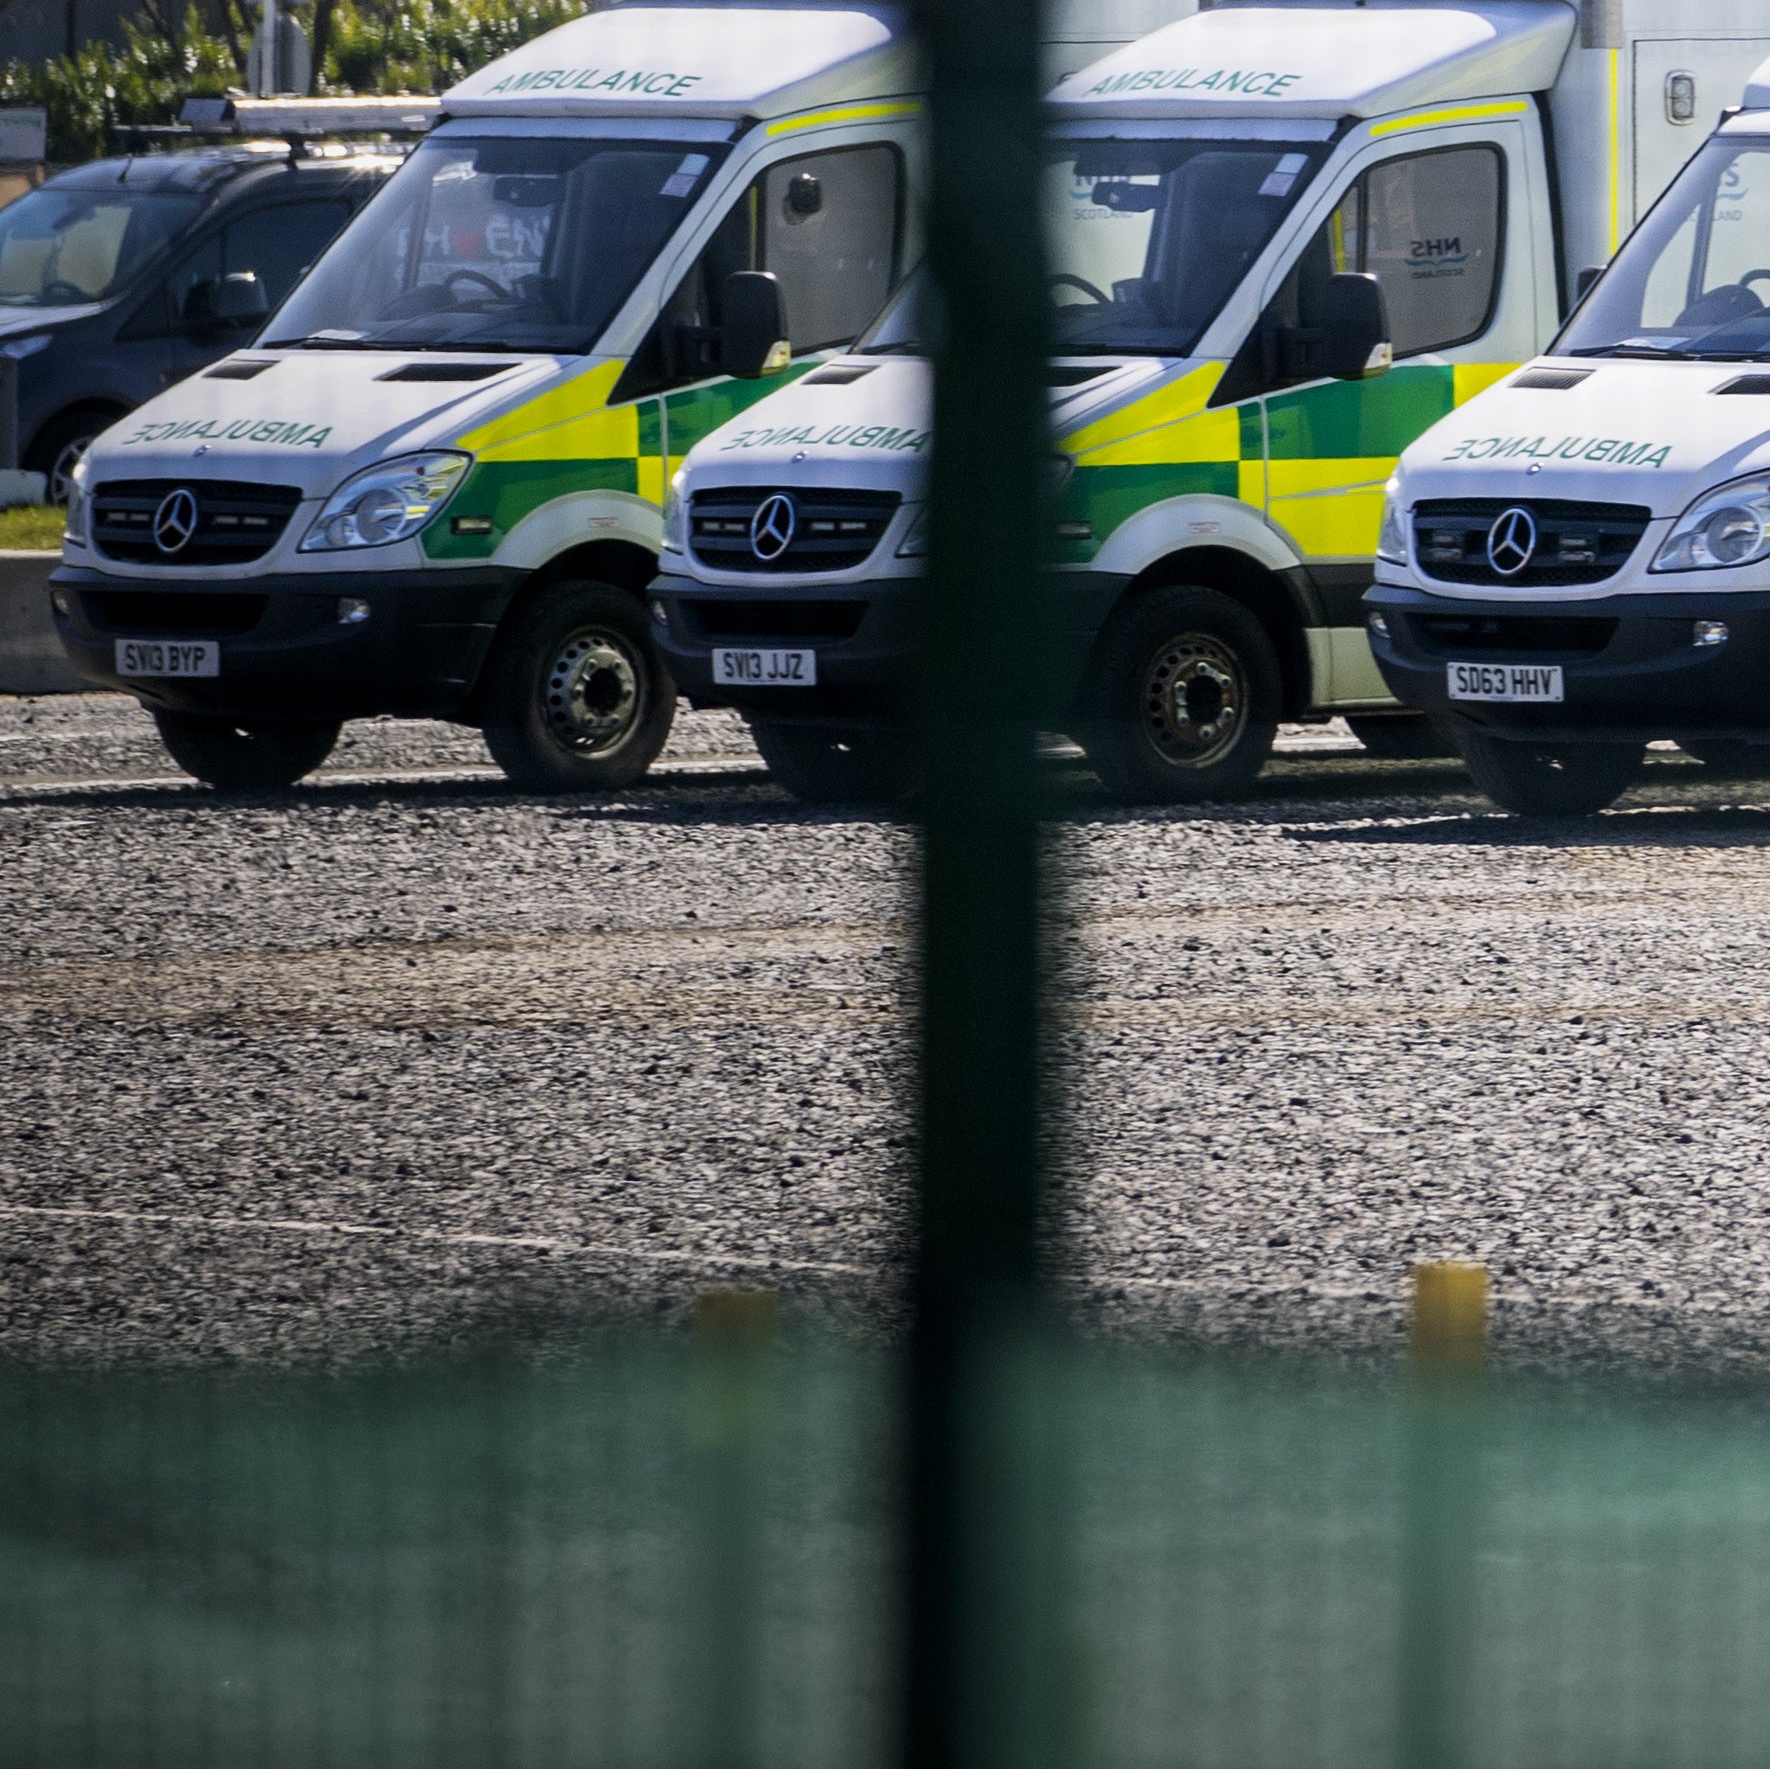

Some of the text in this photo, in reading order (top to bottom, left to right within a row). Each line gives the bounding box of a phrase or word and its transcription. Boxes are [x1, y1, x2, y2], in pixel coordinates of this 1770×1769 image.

[483, 69, 703, 97] AMBULANCE
[1081, 70, 1303, 97] AMBULANCE
[168, 645, 206, 672] BYP
[724, 652, 804, 680] SV13 JJZ
[1457, 666, 1552, 696] SD63 HHV
